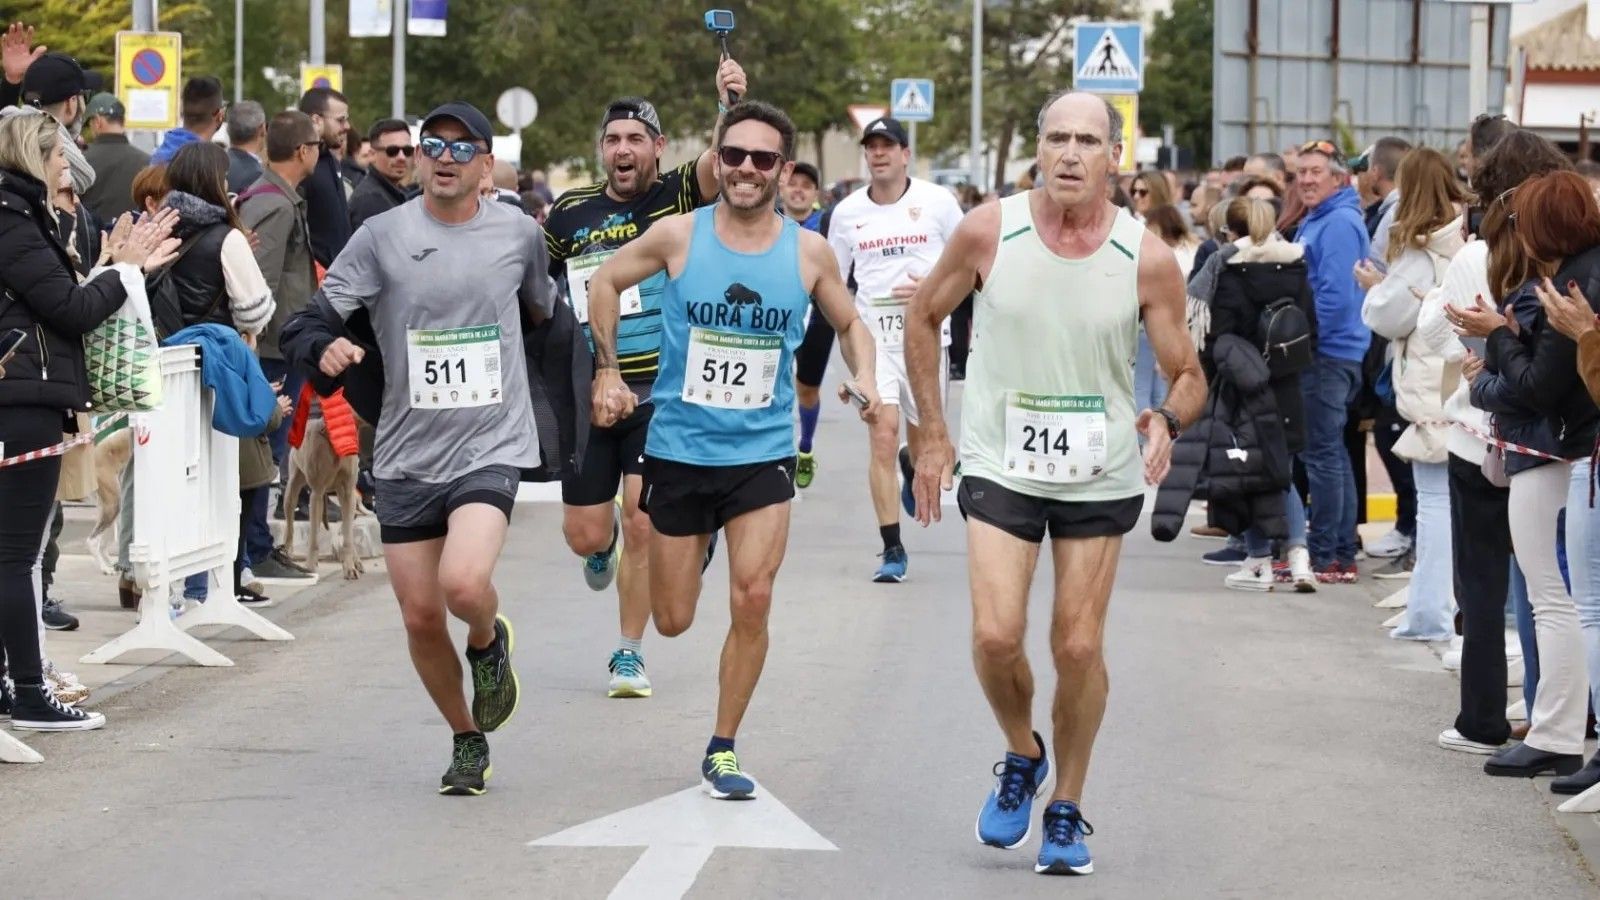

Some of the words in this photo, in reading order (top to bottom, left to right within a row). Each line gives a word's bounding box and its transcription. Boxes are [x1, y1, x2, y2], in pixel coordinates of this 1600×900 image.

[859, 235, 928, 251] MARATHON
[882, 246, 906, 257] BET
[687, 301, 741, 328] KORA
[751, 304, 792, 332] BOX
[425, 358, 466, 385] 511
[702, 358, 747, 386] 512
[1023, 425, 1070, 456] 214
